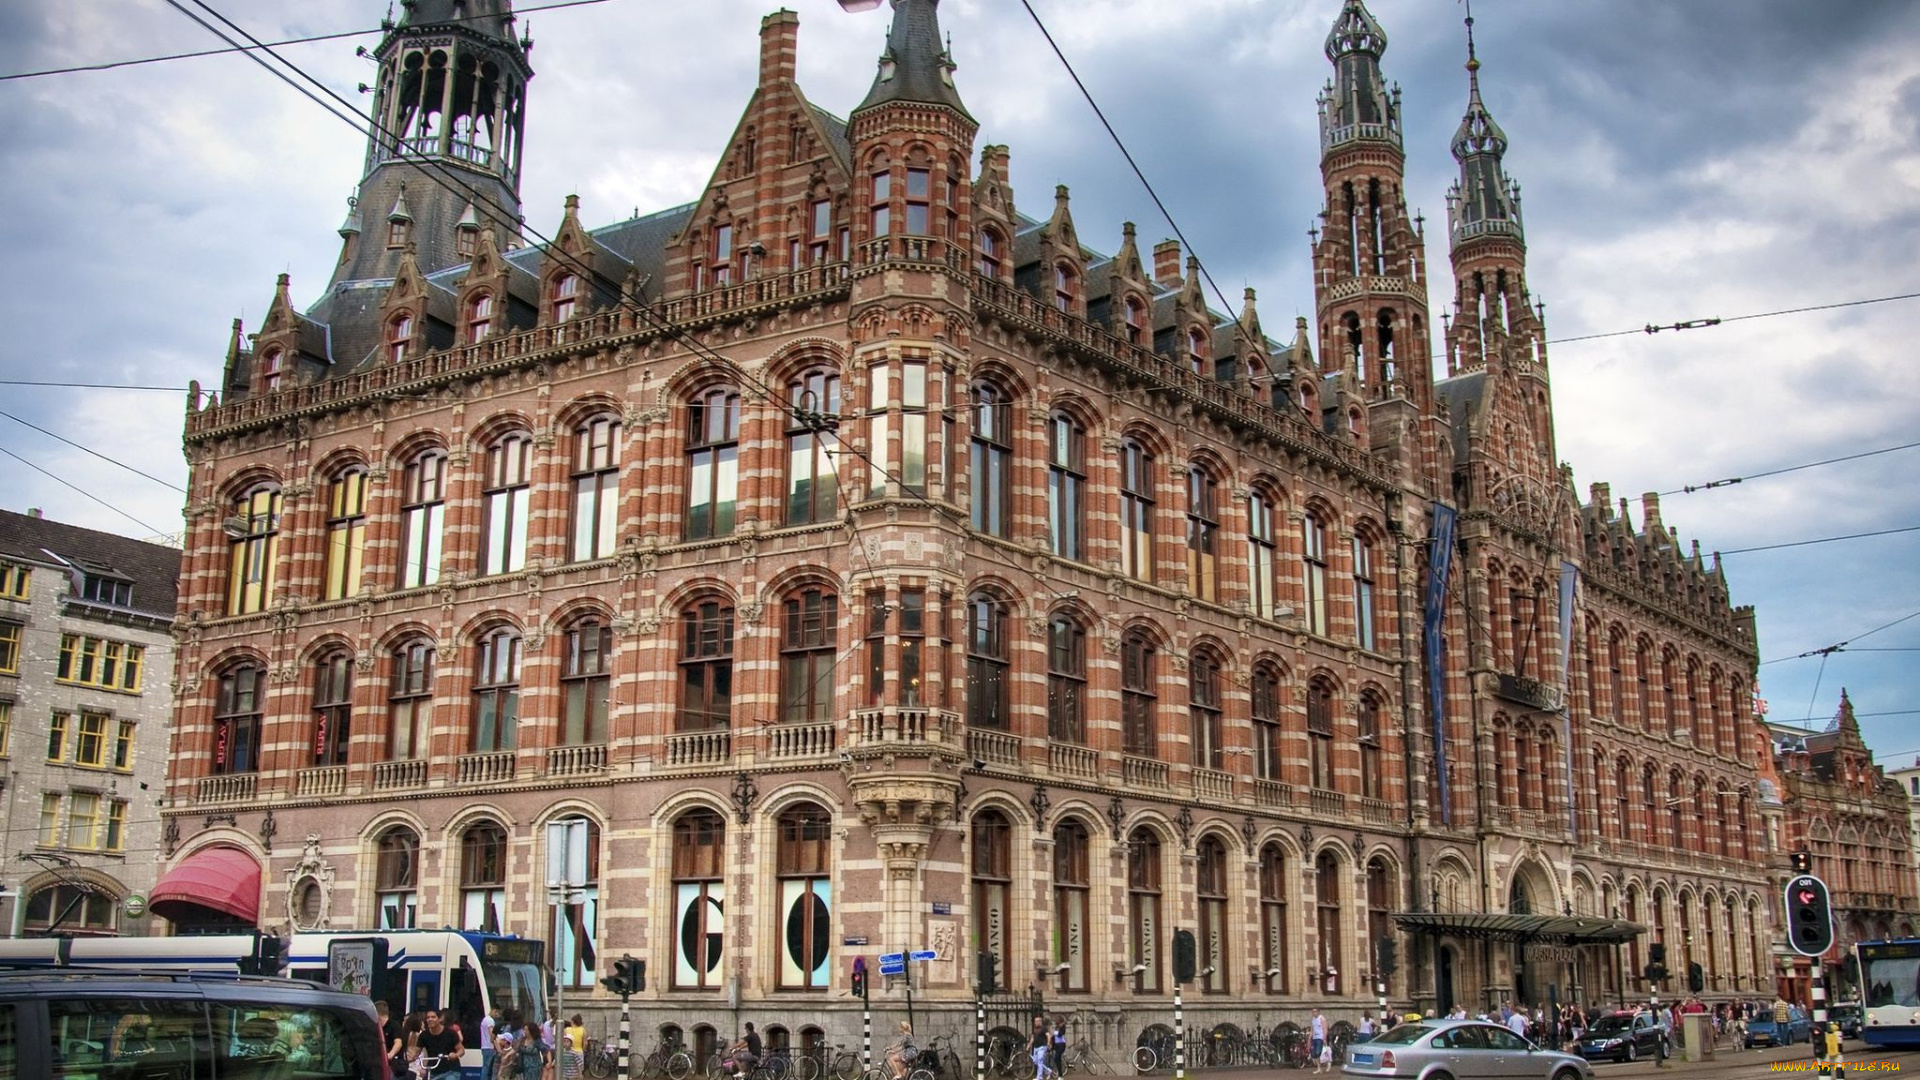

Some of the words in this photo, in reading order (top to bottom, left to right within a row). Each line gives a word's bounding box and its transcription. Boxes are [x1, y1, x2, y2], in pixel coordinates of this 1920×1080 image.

[217, 725, 227, 763] REPLAY
[316, 714, 327, 754] REPLAY
[1070, 923, 1079, 955] MNG
